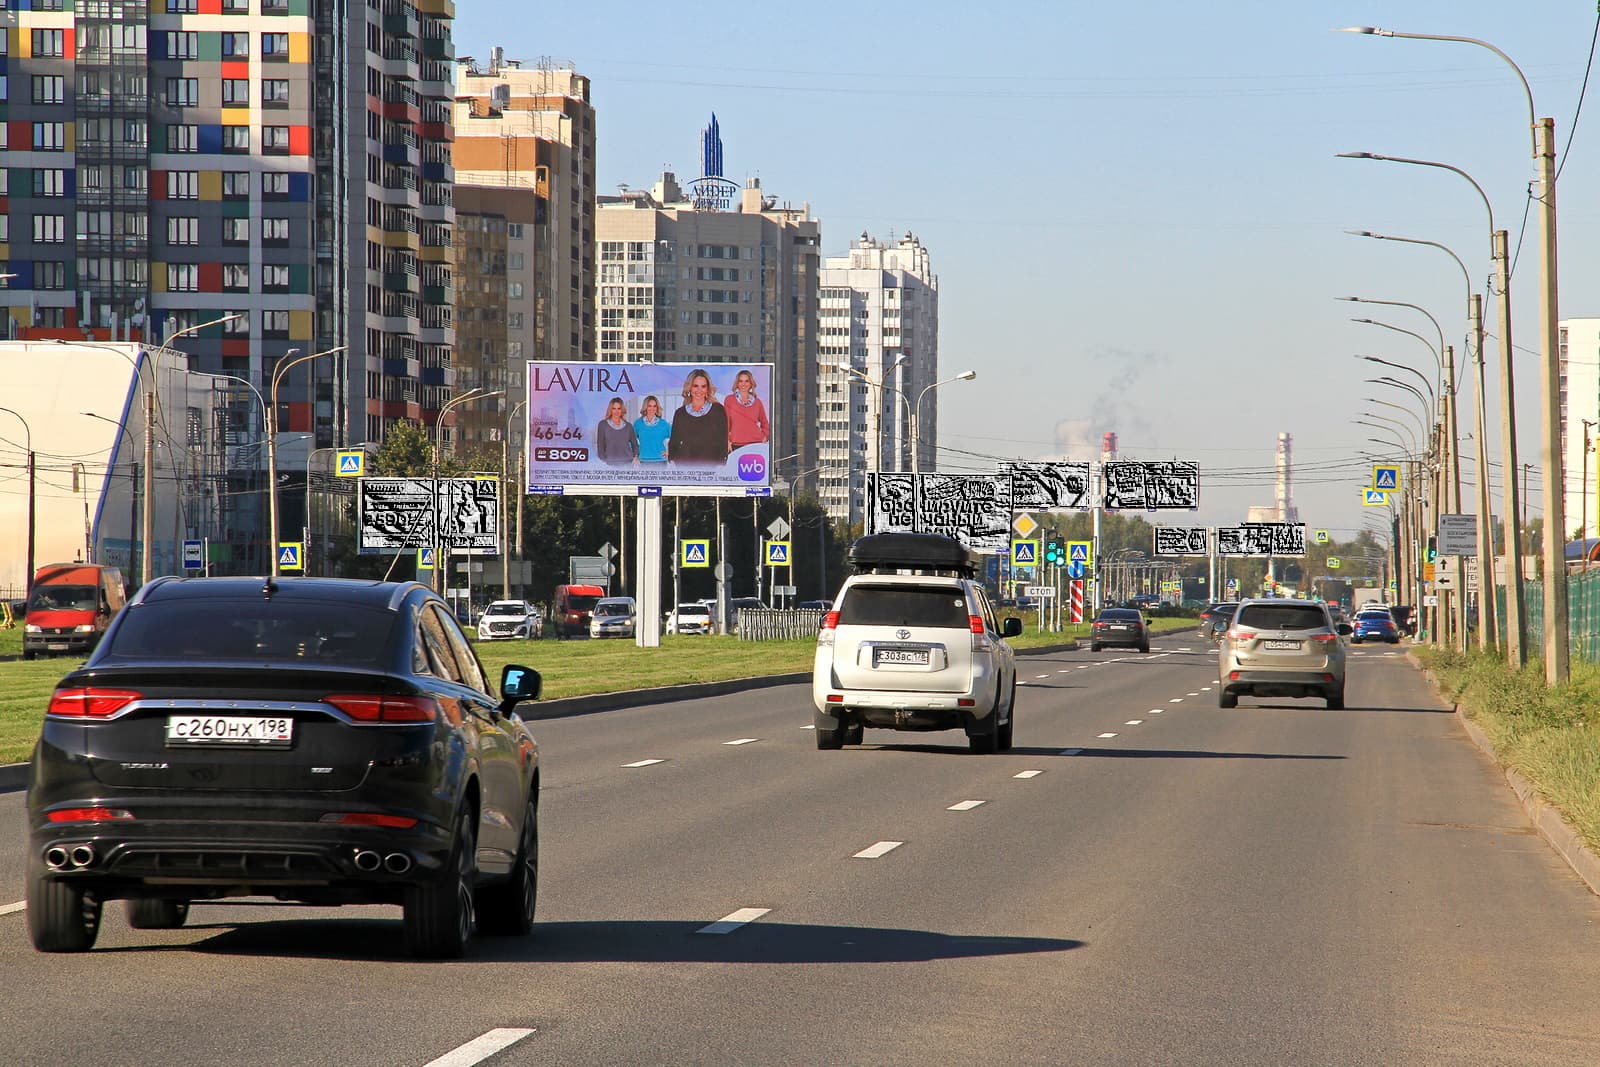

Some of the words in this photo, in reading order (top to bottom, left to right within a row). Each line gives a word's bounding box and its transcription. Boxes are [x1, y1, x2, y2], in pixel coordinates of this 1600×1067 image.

[534, 367, 635, 393] LAVIRA
[535, 427, 583, 440] 46-64
[740, 459, 764, 474] wb
[258, 719, 288, 733] 198
